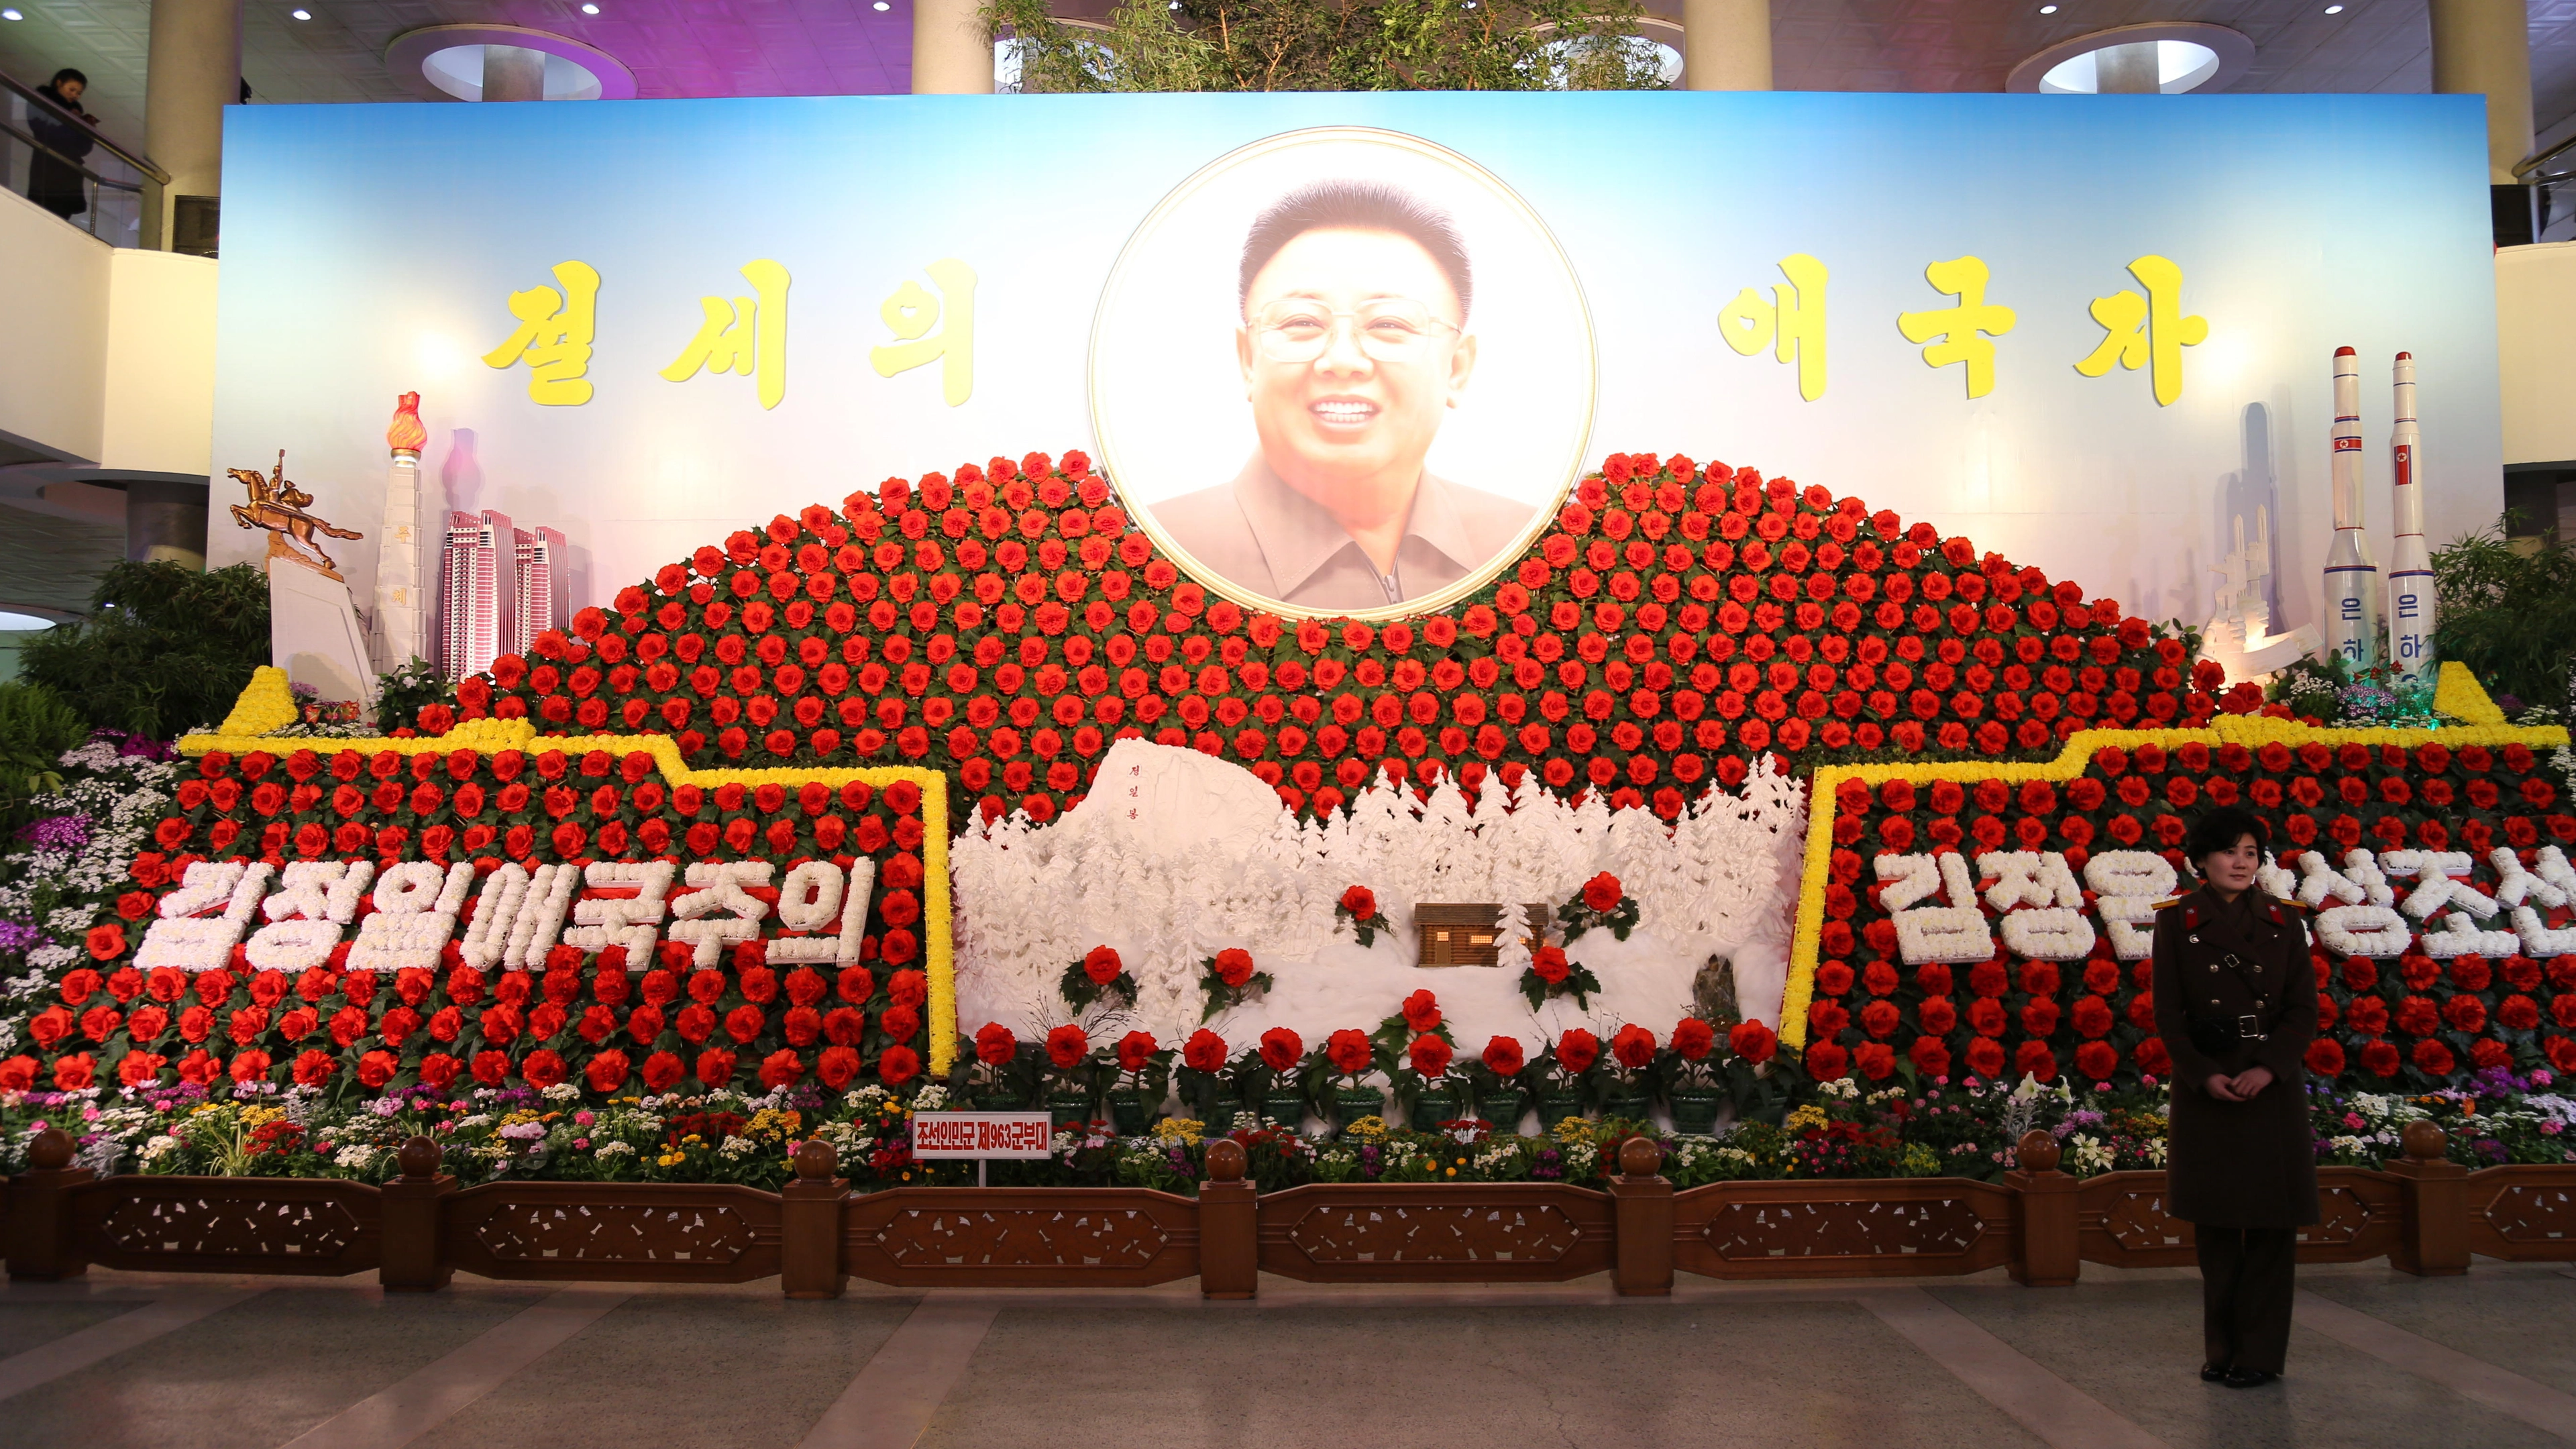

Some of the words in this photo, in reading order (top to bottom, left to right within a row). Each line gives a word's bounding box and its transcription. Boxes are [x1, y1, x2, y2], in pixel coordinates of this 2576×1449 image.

[480, 258, 978, 409] 절세의
[1717, 253, 2209, 407] 애국자
[392, 525, 411, 606] 주체
[1126, 765, 1140, 820] 정일봉
[1873, 844, 2576, 965] 김정은성조선
[916, 1121, 975, 1150] 조선인민군
[977, 1121, 1048, 1150] 제963군부대
